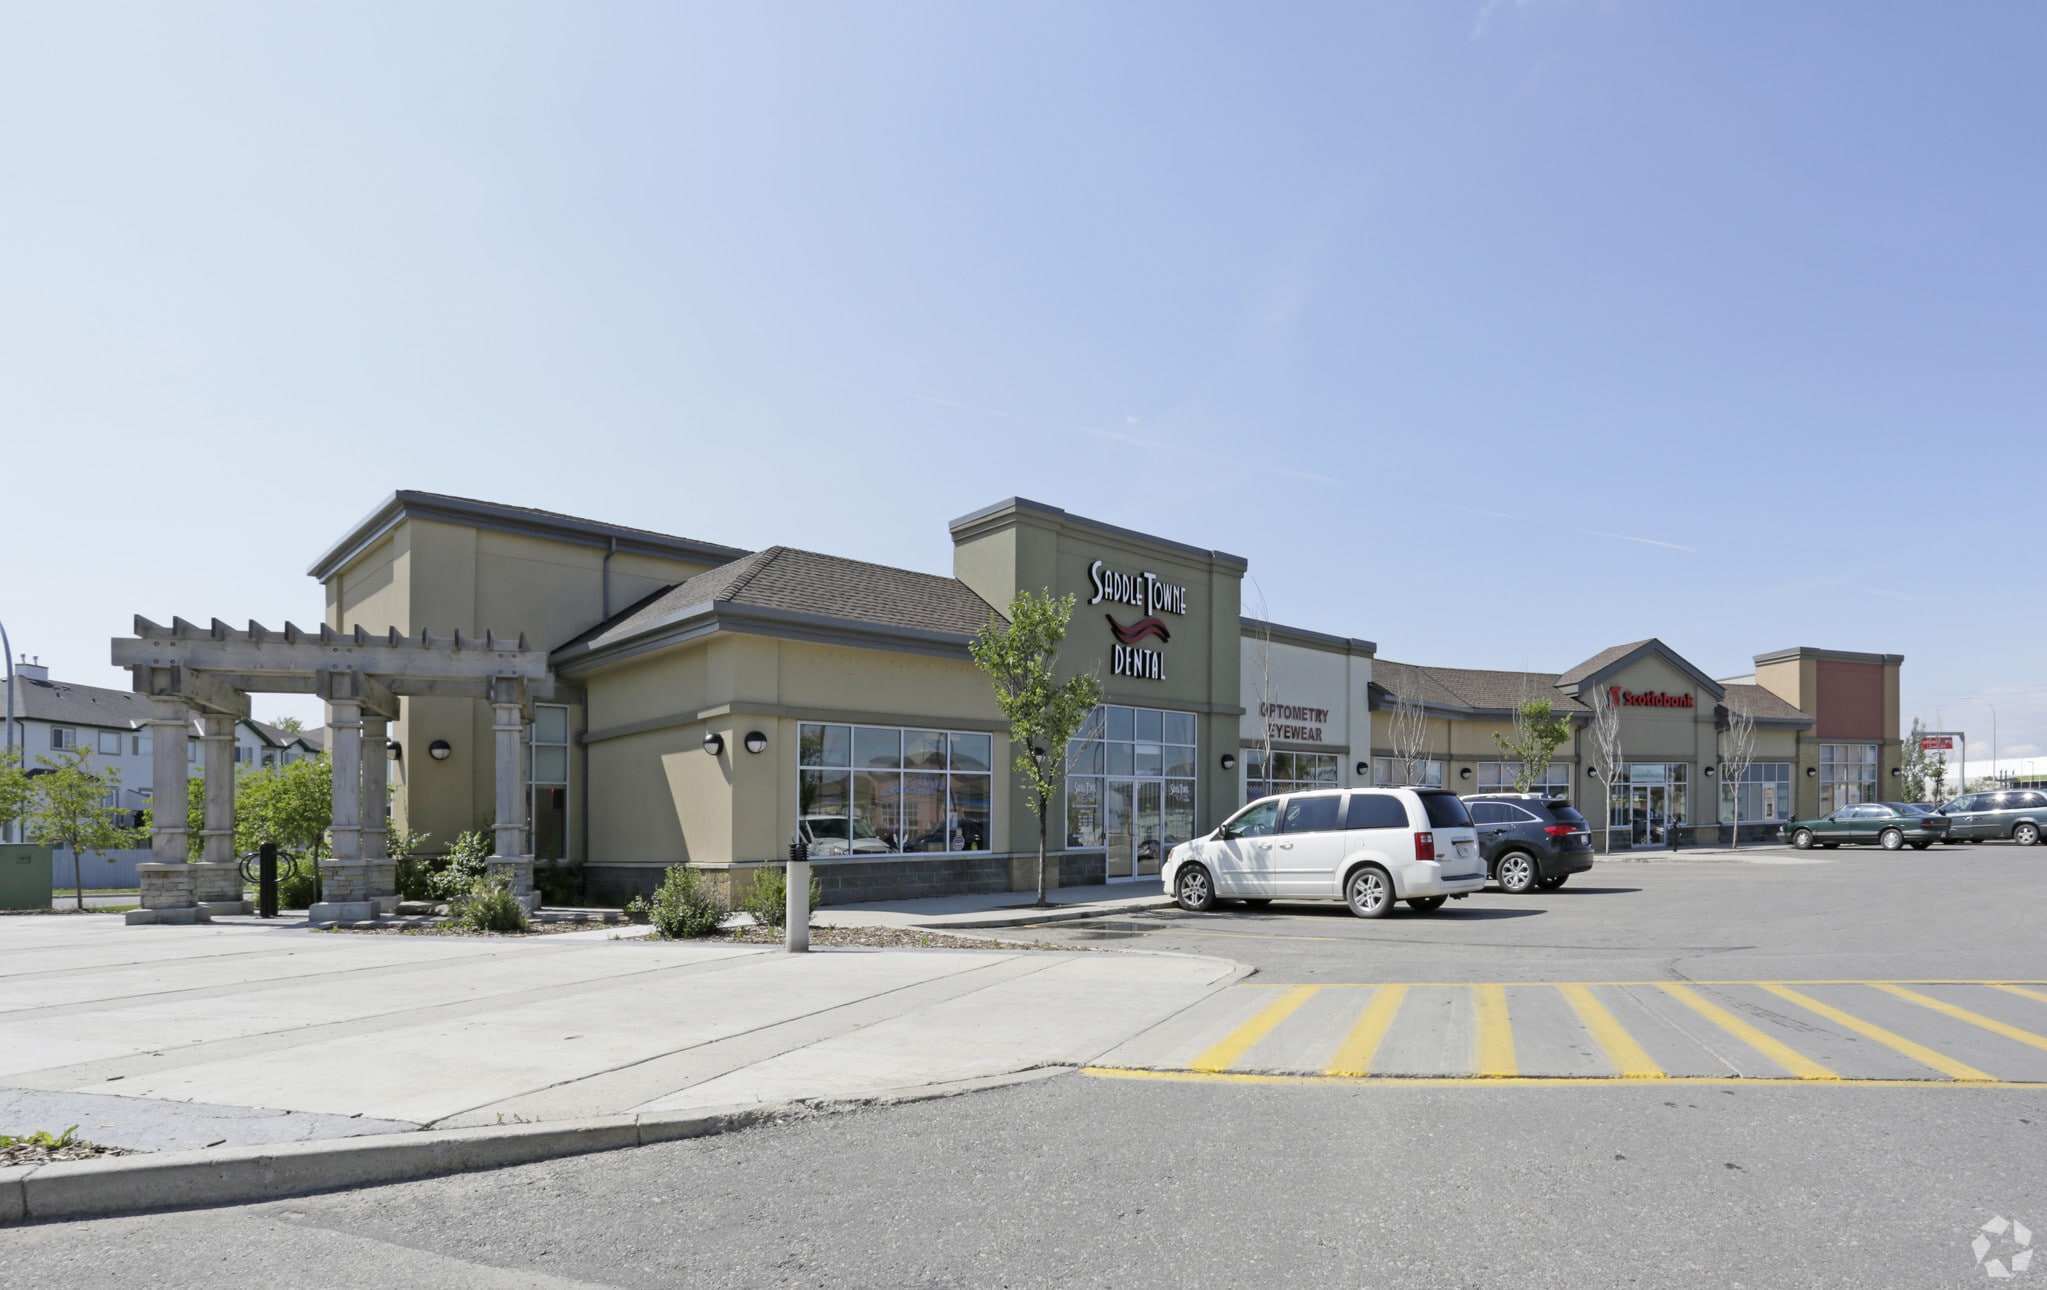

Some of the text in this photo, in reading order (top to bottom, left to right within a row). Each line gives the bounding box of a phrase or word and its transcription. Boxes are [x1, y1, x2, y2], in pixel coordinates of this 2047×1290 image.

[1089, 560, 1187, 615] SADDLE TOWNE
[1111, 644, 1166, 680] DENTAL
[1624, 691, 1693, 708] Scotiabank
[1260, 702, 1328, 723] OPTOMETRY
[1268, 724, 1322, 742] EYEWEAR
